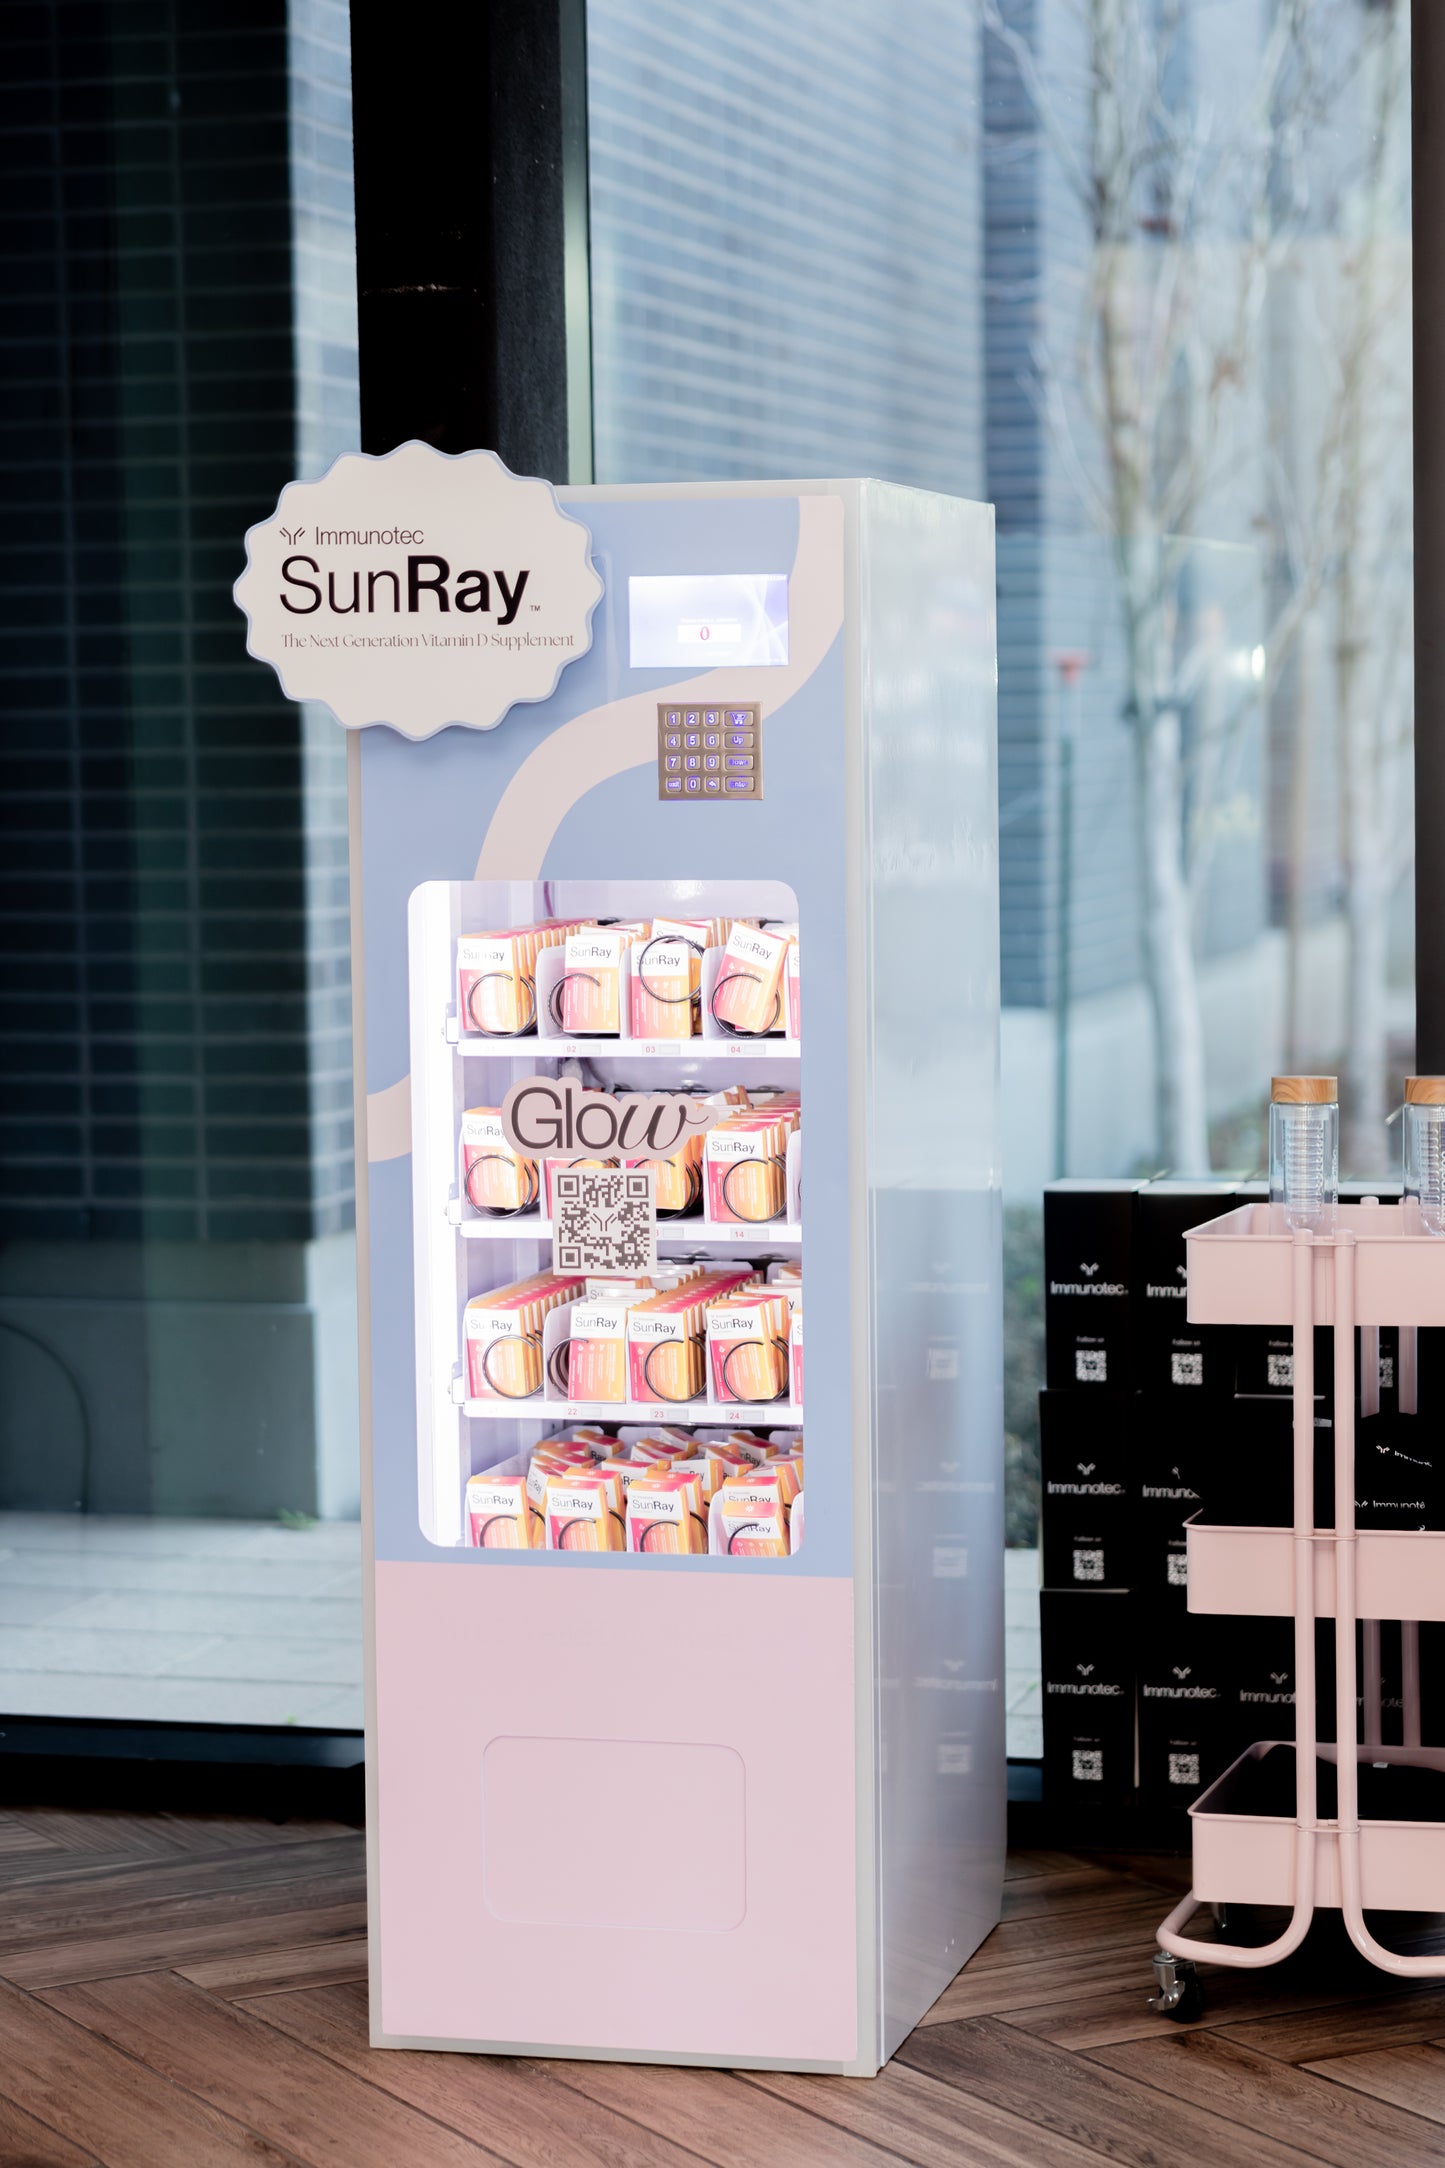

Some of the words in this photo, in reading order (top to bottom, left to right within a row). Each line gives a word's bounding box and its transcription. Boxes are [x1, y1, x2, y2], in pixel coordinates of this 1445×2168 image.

[315, 526, 425, 545] Immunotec
[279, 555, 530, 626] SunRay
[699, 626, 710, 641] 0
[281, 634, 307, 648] The
[310, 634, 339, 648] Next
[342, 634, 419, 648] Generation
[421, 633, 475, 648] Vitamin
[477, 634, 488, 647] D
[491, 632, 575, 651] Supplement
[689, 714, 696, 724] 2
[708, 714, 715, 724] 3
[670, 736, 677, 746] 4
[689, 736, 696, 745] 5
[708, 736, 715, 745] 6
[732, 736, 744, 745] Up
[670, 758, 677, 767] 7
[689, 758, 696, 767] 8
[708, 758, 715, 767] 9
[690, 779, 697, 789] 0
[570, 946, 612, 960] SunRay
[733, 935, 772, 959] SunRay
[635, 953, 680, 967] SunRay
[566, 1045, 577, 1053] 02
[511, 1086, 709, 1151] Glow
[712, 1141, 755, 1154] SunRay
[1050, 1281, 1125, 1295] Immunotec
[470, 1319, 512, 1331] SuRay
[575, 1317, 618, 1329] SunRay
[633, 1322, 676, 1335] SunRay
[711, 1319, 754, 1330] SunRay
[729, 1412, 740, 1420] 24
[1047, 1481, 1121, 1494] Immunotec
[1142, 1484, 1199, 1499] Immuno
[472, 1495, 514, 1507] SunRay
[552, 1497, 593, 1510] SunRay
[632, 1499, 674, 1512] SunRay
[1047, 1682, 1121, 1695] Immunotec
[1143, 1684, 1217, 1698] Immunotec
